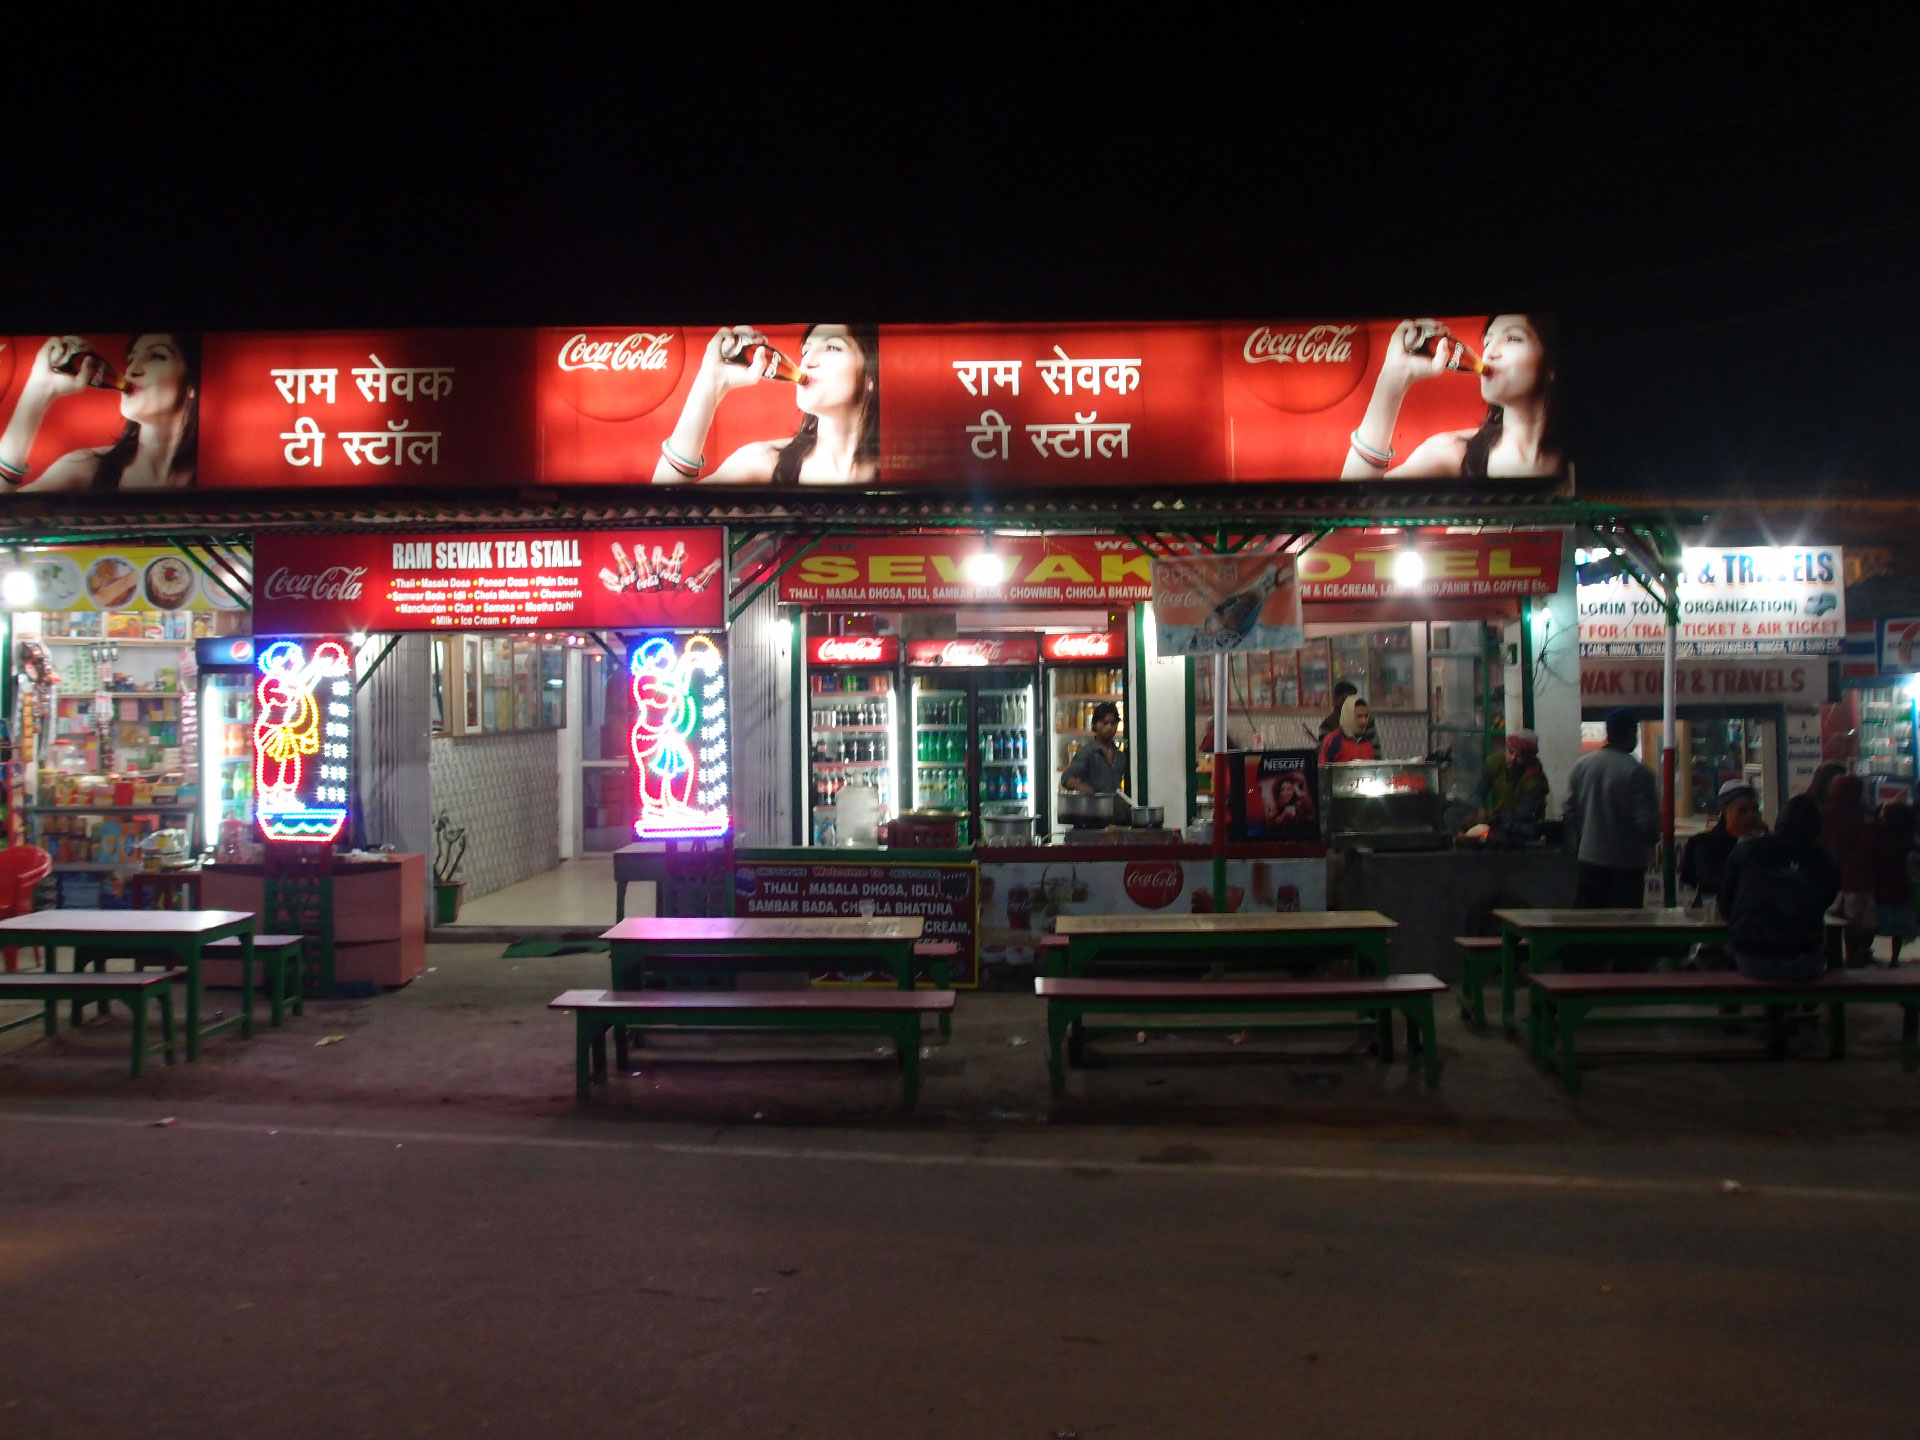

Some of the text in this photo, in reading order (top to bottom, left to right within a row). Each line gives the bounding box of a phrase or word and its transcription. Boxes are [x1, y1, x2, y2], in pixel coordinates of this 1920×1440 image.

[558, 333, 674, 371] Coca-Cola
[1243, 324, 1358, 364] Coca-Cola
[270, 353, 455, 403] राम सेवक
[952, 344, 1142, 396] राम सेवक
[280, 417, 442, 467] टी स्टॉल
[966, 409, 1131, 460] टी स्टॉल
[392, 539, 582, 569] RAM SEVAK TEA STALL
[1722, 552, 1834, 584] TRELS
[264, 566, 368, 600] Coca-Cola
[395, 576, 579, 588] Thali Masala Dosa Paneer Dosa Plain Dosa
[540, 588, 583, 599] Chowmein
[826, 588, 866, 599] MASALA
[1066, 586, 1106, 599] CHHOLA
[1473, 580, 1491, 594] TEA
[1493, 579, 1530, 593] COFFEE
[400, 603, 447, 613] Manchurian
[454, 603, 474, 613] Chat
[483, 602, 516, 613] Samosa
[555, 601, 574, 612] Dahi
[1684, 599, 1797, 616] ORGANIZATION)
[436, 614, 538, 625] Milk Ice Cream Paneer
[1682, 622, 1736, 637] TICKET
[1742, 621, 1752, 635] &
[1757, 621, 1782, 635] AIR
[1786, 619, 1840, 635] TICKET
[1580, 669, 1624, 695] WAK
[1691, 668, 1705, 694] &
[1706, 667, 1806, 694] TRAVELS
[809, 883, 859, 895] MASALA
[862, 883, 908, 898] DHOSA,
[748, 900, 799, 913] SAMBAR
[802, 900, 838, 915] BADA,
[895, 901, 953, 915] BHATURA
